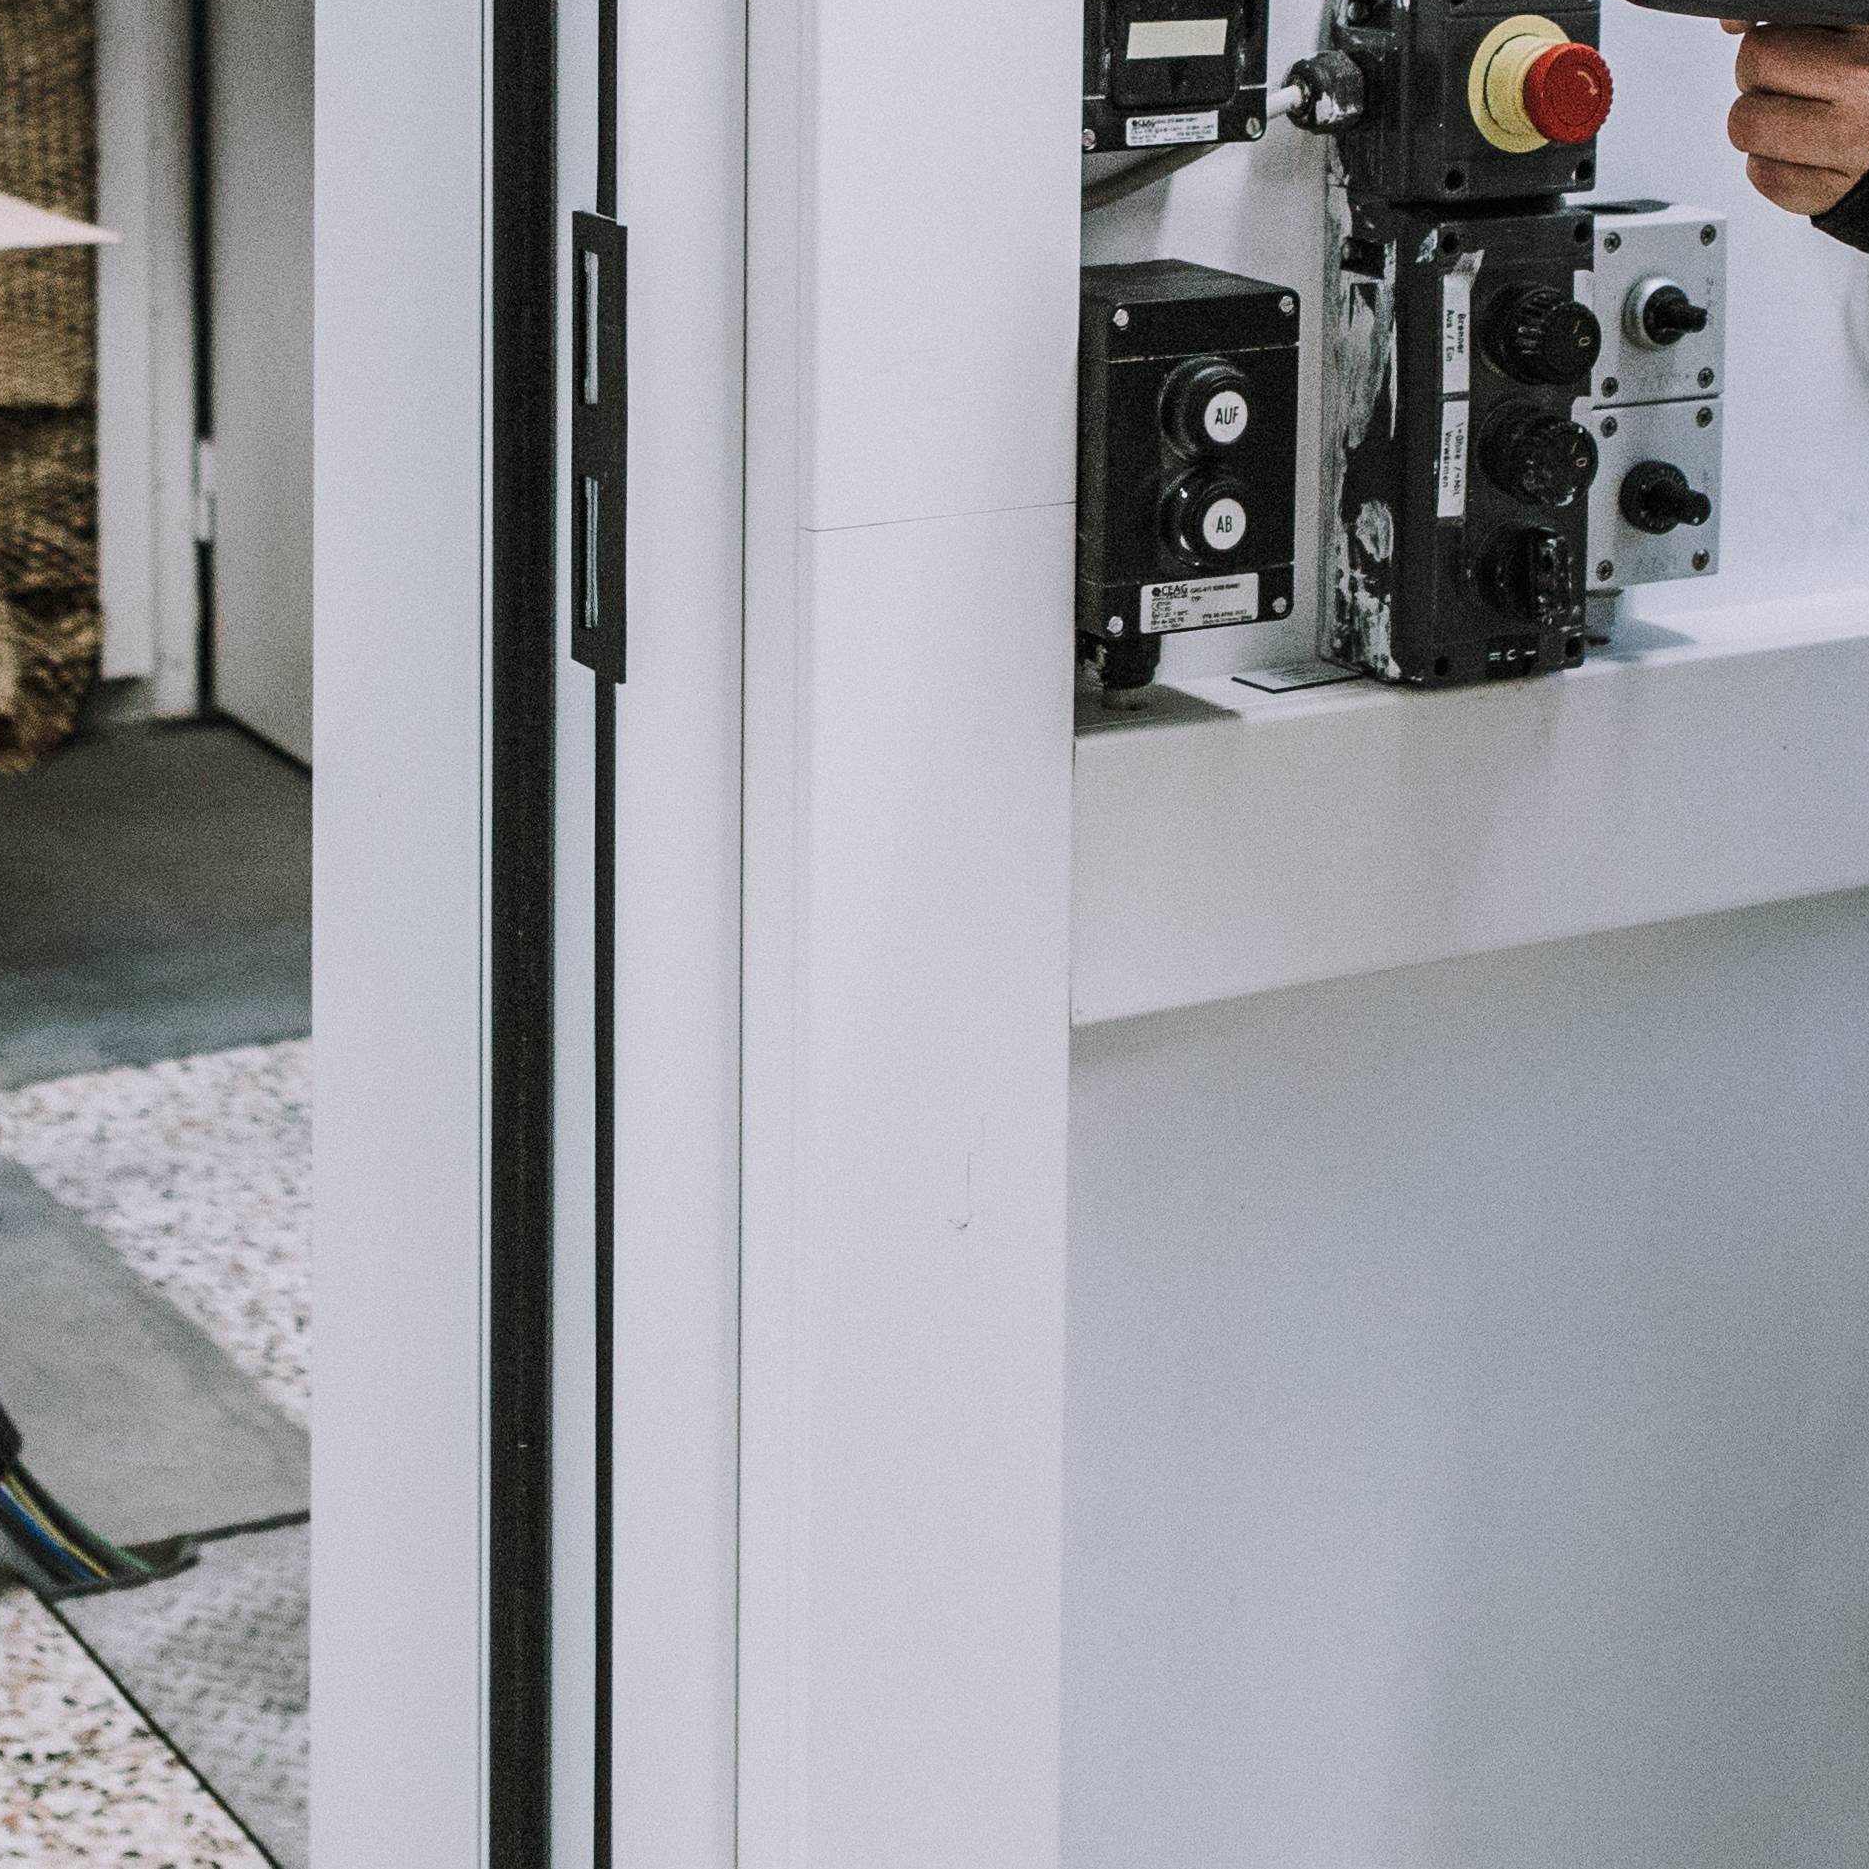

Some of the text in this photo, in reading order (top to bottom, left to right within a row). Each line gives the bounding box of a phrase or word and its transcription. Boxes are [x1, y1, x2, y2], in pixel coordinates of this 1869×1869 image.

[1457, 313, 1467, 354] Brenner
[1214, 405, 1240, 426] AUF
[1215, 515, 1233, 533] AB
[1161, 584, 1188, 596] CEAG
